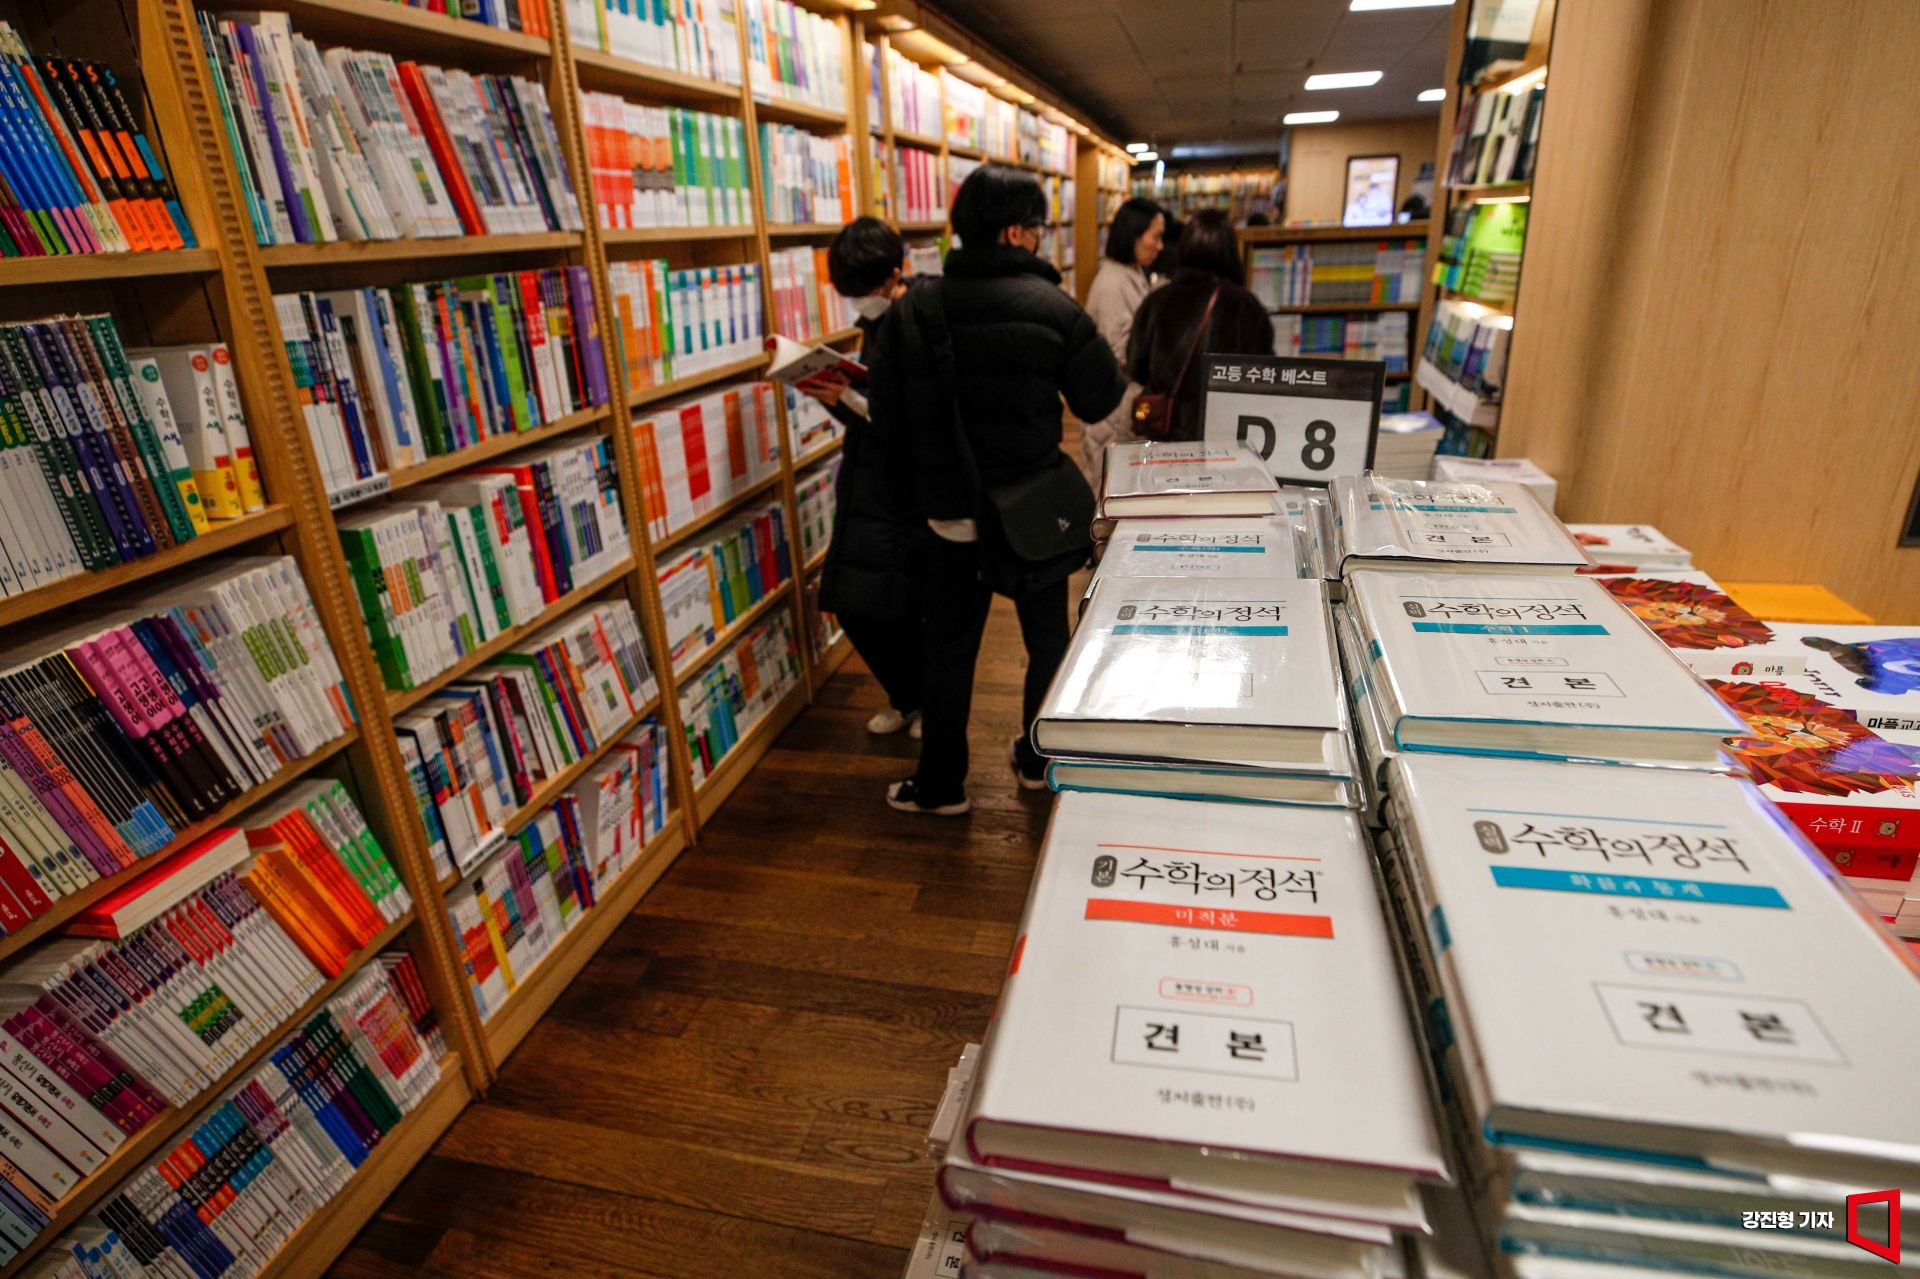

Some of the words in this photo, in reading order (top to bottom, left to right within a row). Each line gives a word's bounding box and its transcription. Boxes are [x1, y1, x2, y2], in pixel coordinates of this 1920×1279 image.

[1212, 365, 1242, 382] 고등
[1246, 367, 1276, 384] 수학
[1281, 368, 1327, 385] 베스트
[1301, 419, 1336, 471] 8
[1138, 605, 1281, 621] 수학의정석
[1428, 602, 1587, 621] 수학의정석
[1765, 665, 1785, 677] 마플
[1500, 676, 1533, 690] 견
[1564, 677, 1597, 690] 본
[1809, 816, 1847, 834] 수학
[1510, 822, 1750, 873] 수학의정석
[1120, 857, 1318, 904] 수학의정석
[1175, 908, 1239, 928] 미적분
[1638, 1001, 1692, 1036] 견
[1740, 1010, 1799, 1046] 본
[1143, 1022, 1180, 1053] 견
[1226, 1031, 1267, 1062] 본
